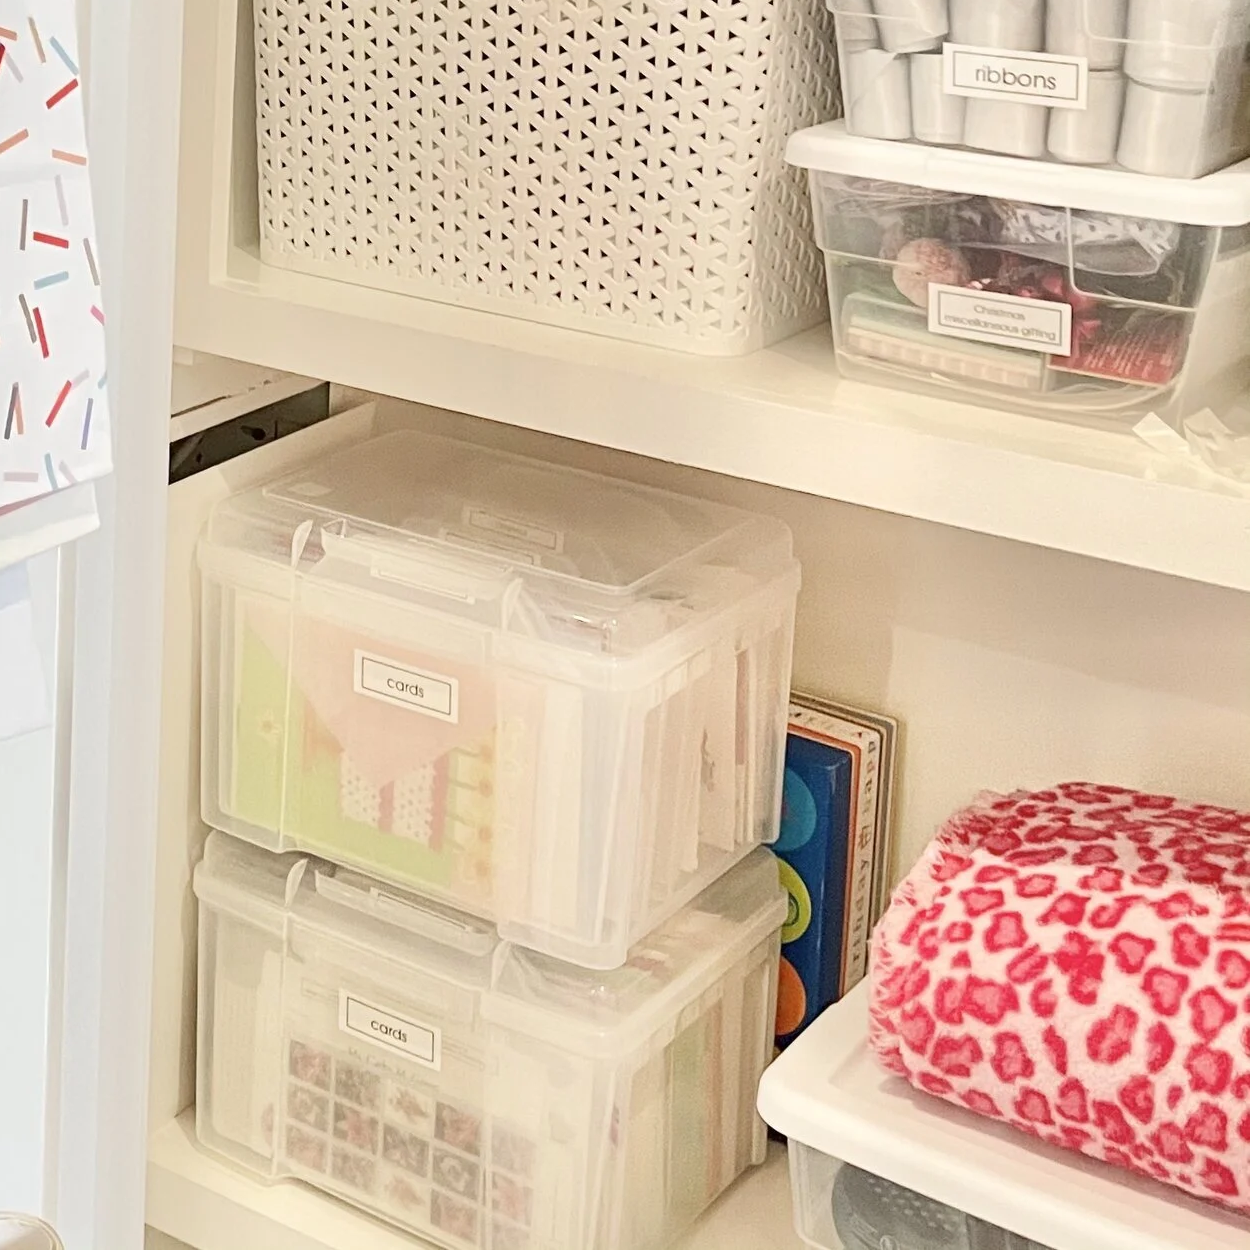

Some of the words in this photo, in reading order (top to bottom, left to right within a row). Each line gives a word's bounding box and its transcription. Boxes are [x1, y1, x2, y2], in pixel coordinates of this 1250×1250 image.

[975, 64, 1057, 91] ribbons
[973, 304, 1026, 321] Christmas
[944, 314, 1020, 334] miscellaneous
[1021, 327, 1056, 342] gifting
[386, 677, 425, 699] cards
[370, 1019, 408, 1043] cards
